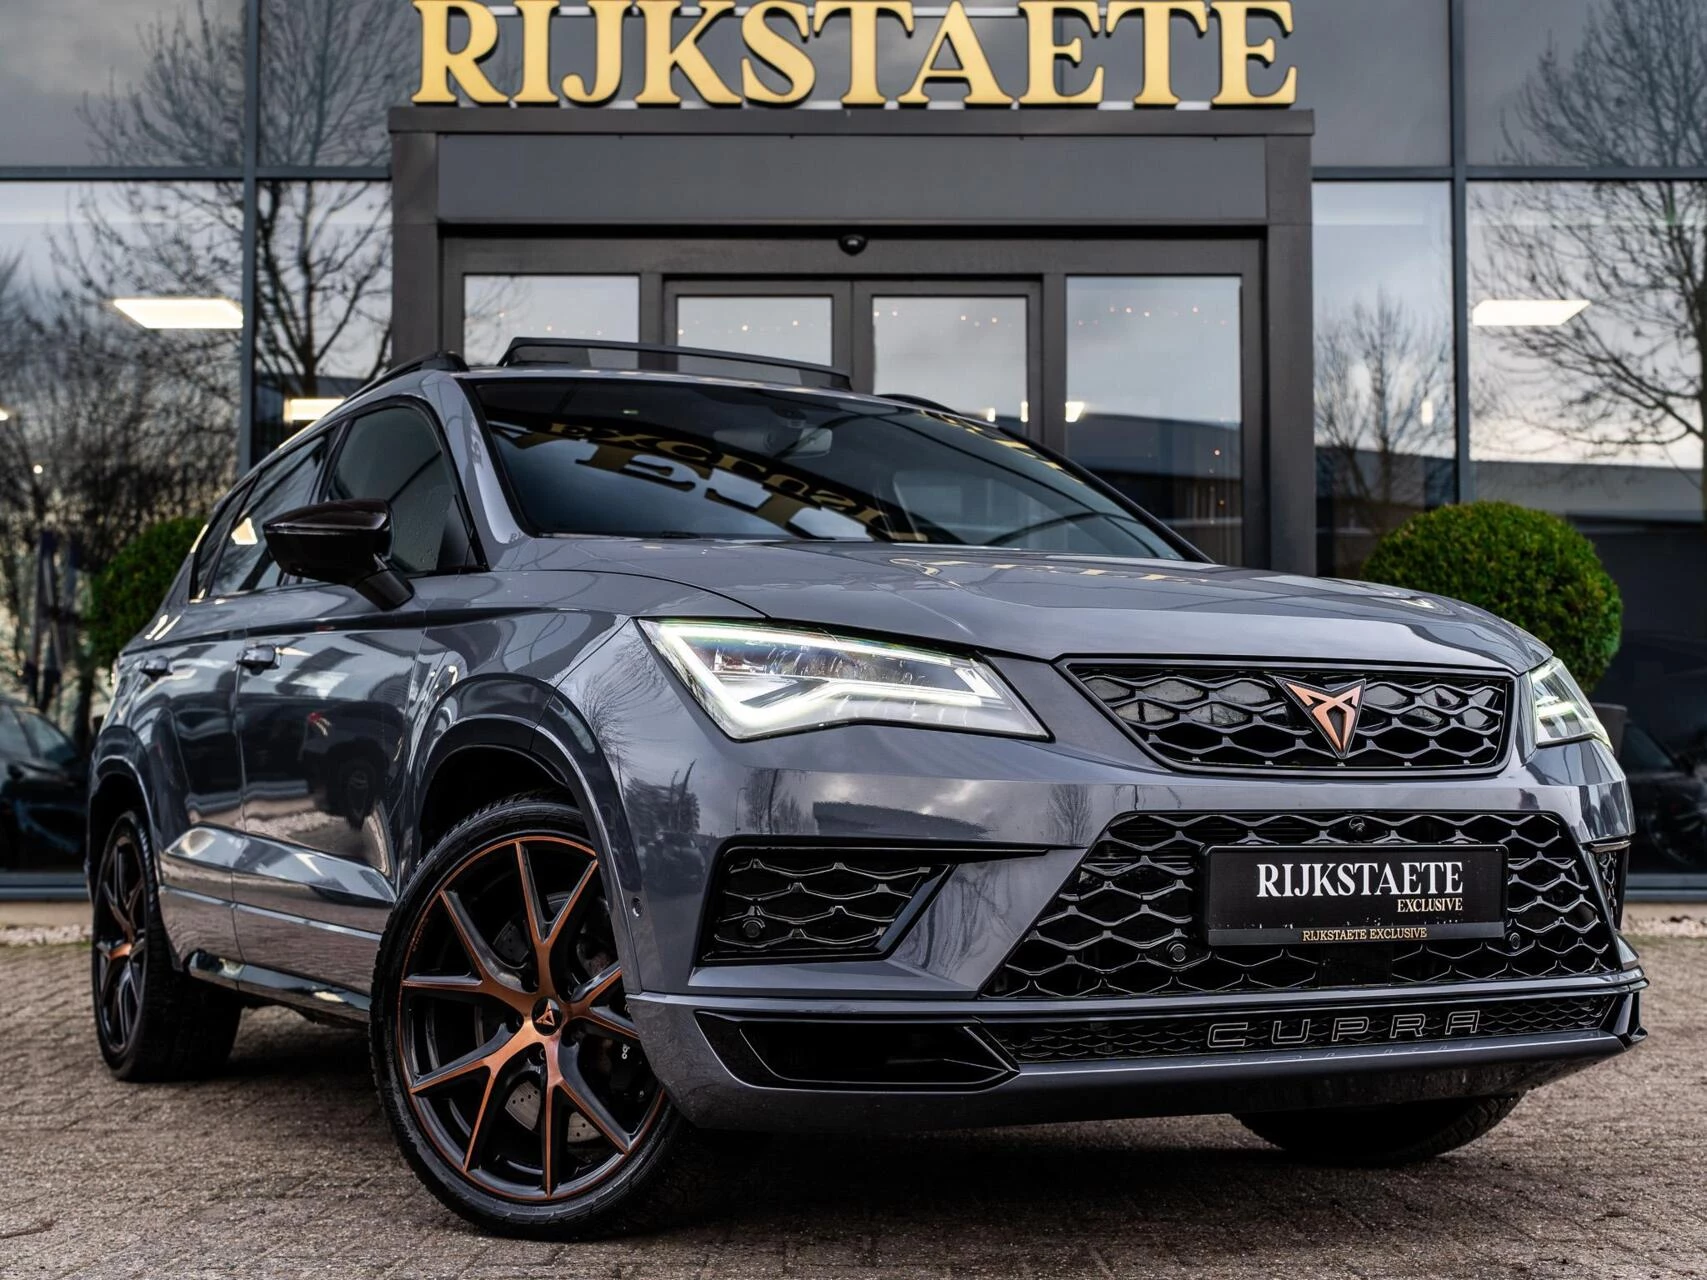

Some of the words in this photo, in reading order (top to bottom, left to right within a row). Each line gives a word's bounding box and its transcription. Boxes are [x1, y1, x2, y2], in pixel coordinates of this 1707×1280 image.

[411, 0, 1298, 106] RIJKSTAETE
[1256, 861, 1464, 897] RIJKSTAETE
[1396, 897, 1463, 913] EXCLUSIVE
[1302, 928, 1367, 942] RIJKSTAETE
[1369, 927, 1428, 940] EXCLUSIVE
[1207, 1010, 1481, 1048] CUPRA
